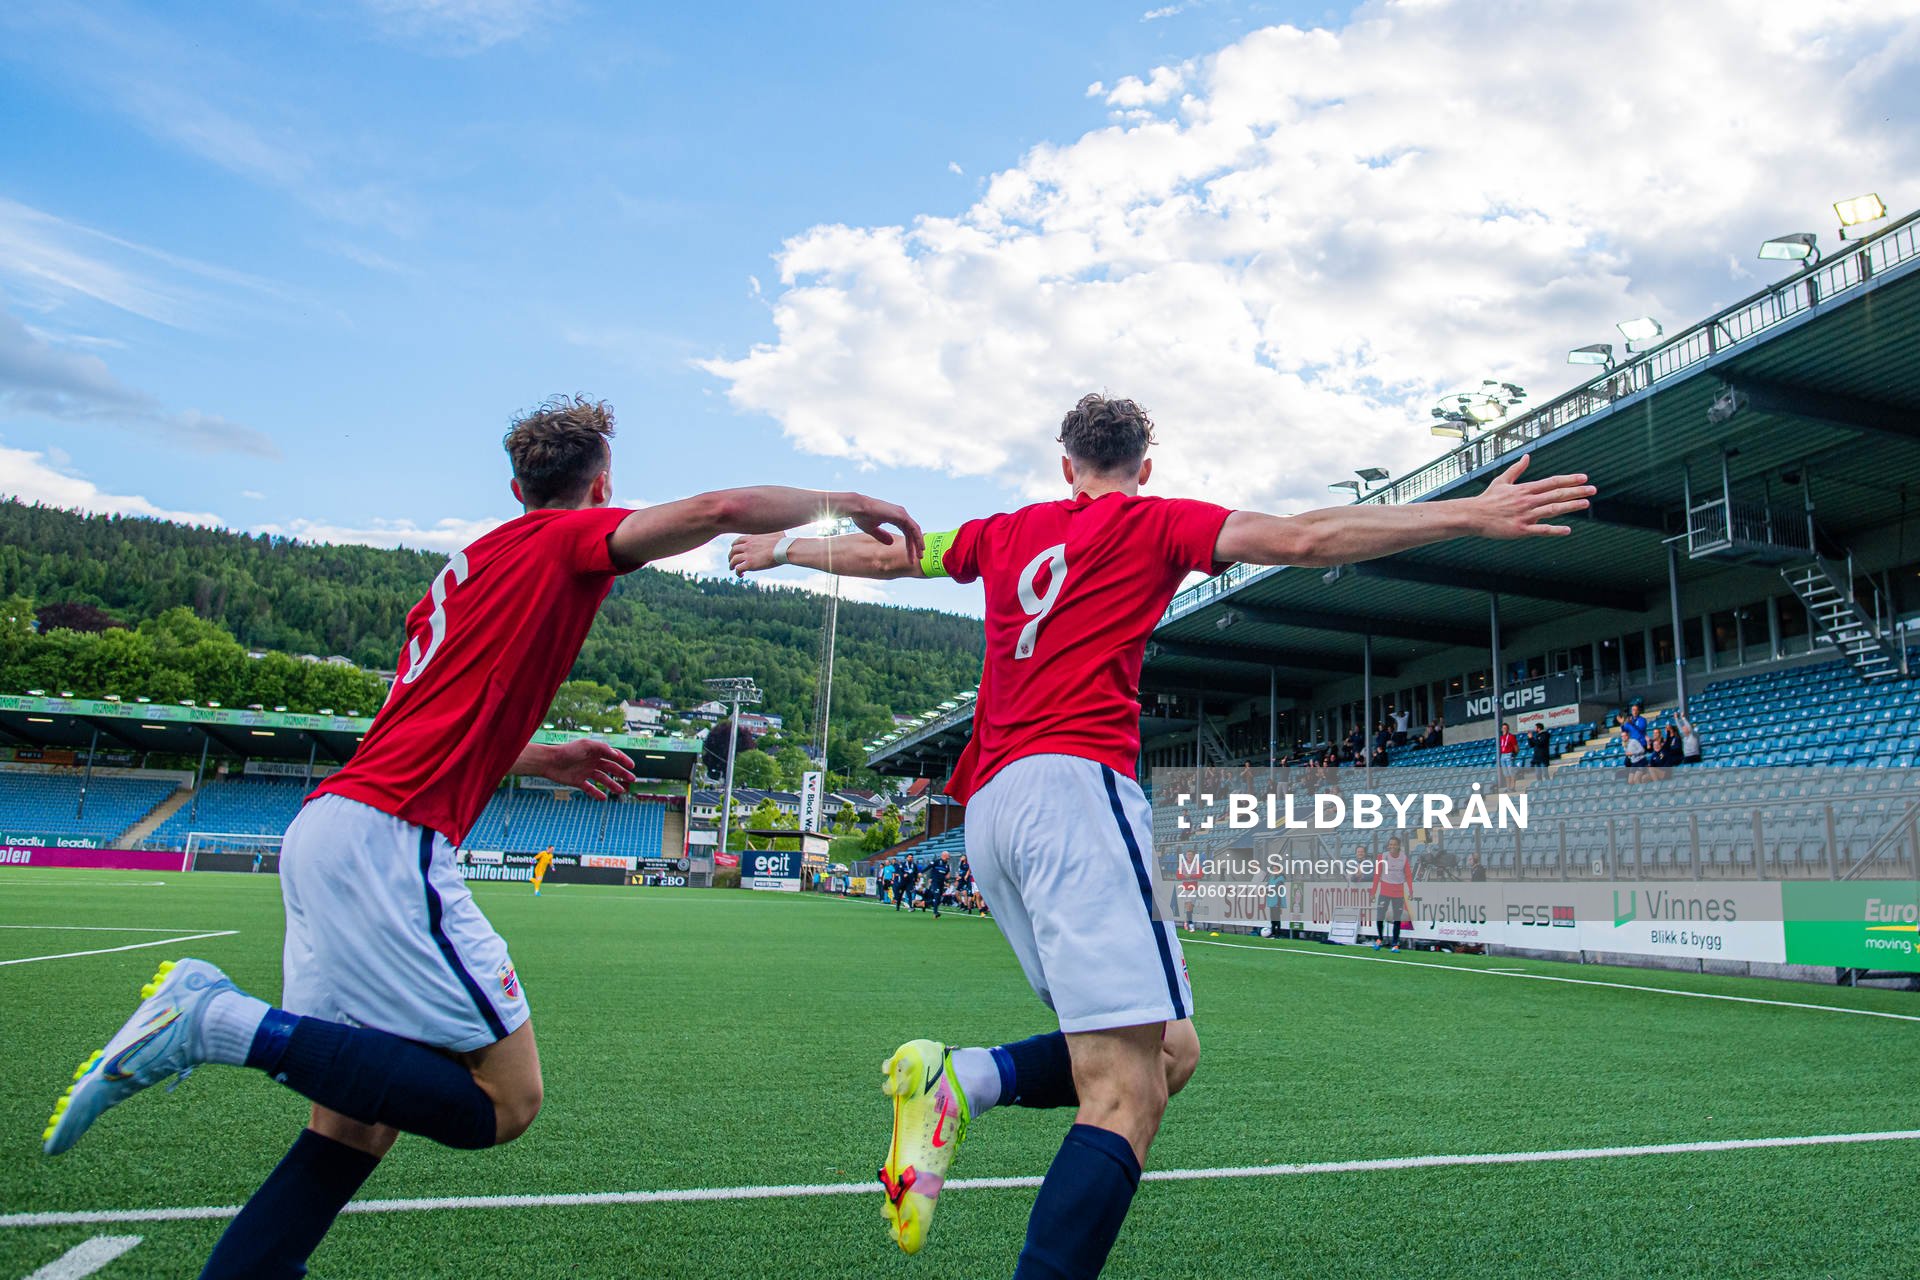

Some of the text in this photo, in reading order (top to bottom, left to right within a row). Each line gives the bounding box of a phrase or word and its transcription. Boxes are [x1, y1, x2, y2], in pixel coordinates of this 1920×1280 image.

[933, 535, 943, 570] RESPECT
[1014, 543, 1068, 660] 9
[0, 696, 20, 710] IWI
[806, 793, 816, 816] Block
[6, 835, 97, 850] leadly leadly
[754, 853, 791, 872] ecit
[1413, 896, 1487, 930] Trysilhus
[1507, 904, 1550, 927] PSS
[1645, 890, 1737, 922] Vinnes
[1651, 930, 1722, 951] Blikk & bygg
[1865, 938, 1912, 954] moving
